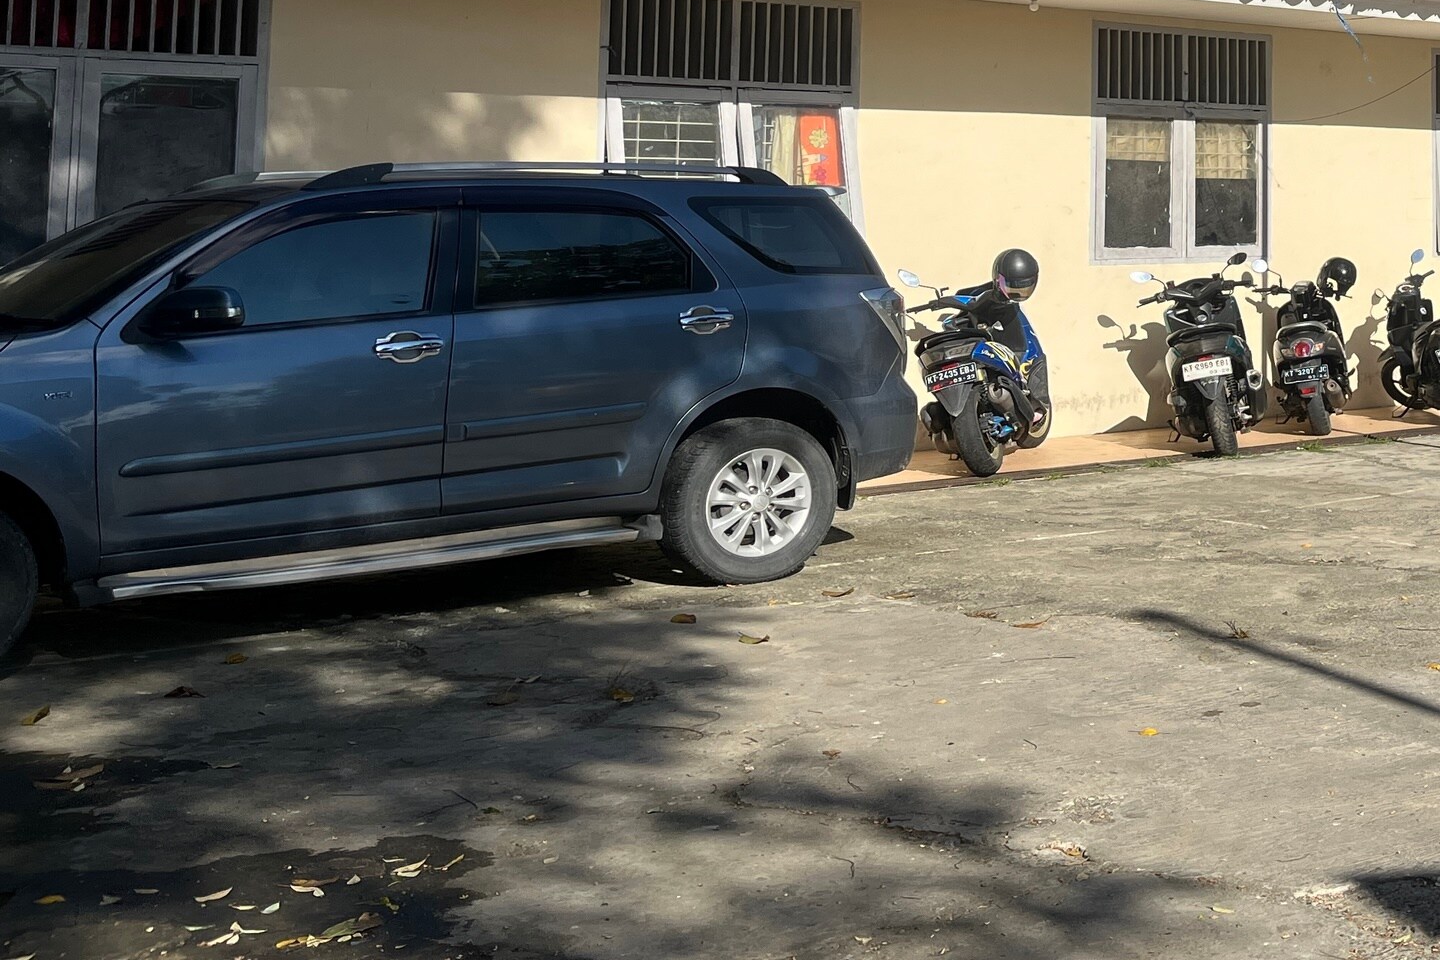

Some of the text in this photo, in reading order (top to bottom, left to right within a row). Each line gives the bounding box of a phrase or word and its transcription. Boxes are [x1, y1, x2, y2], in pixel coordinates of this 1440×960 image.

[927, 365, 975, 385] KT 2435 EBJ
